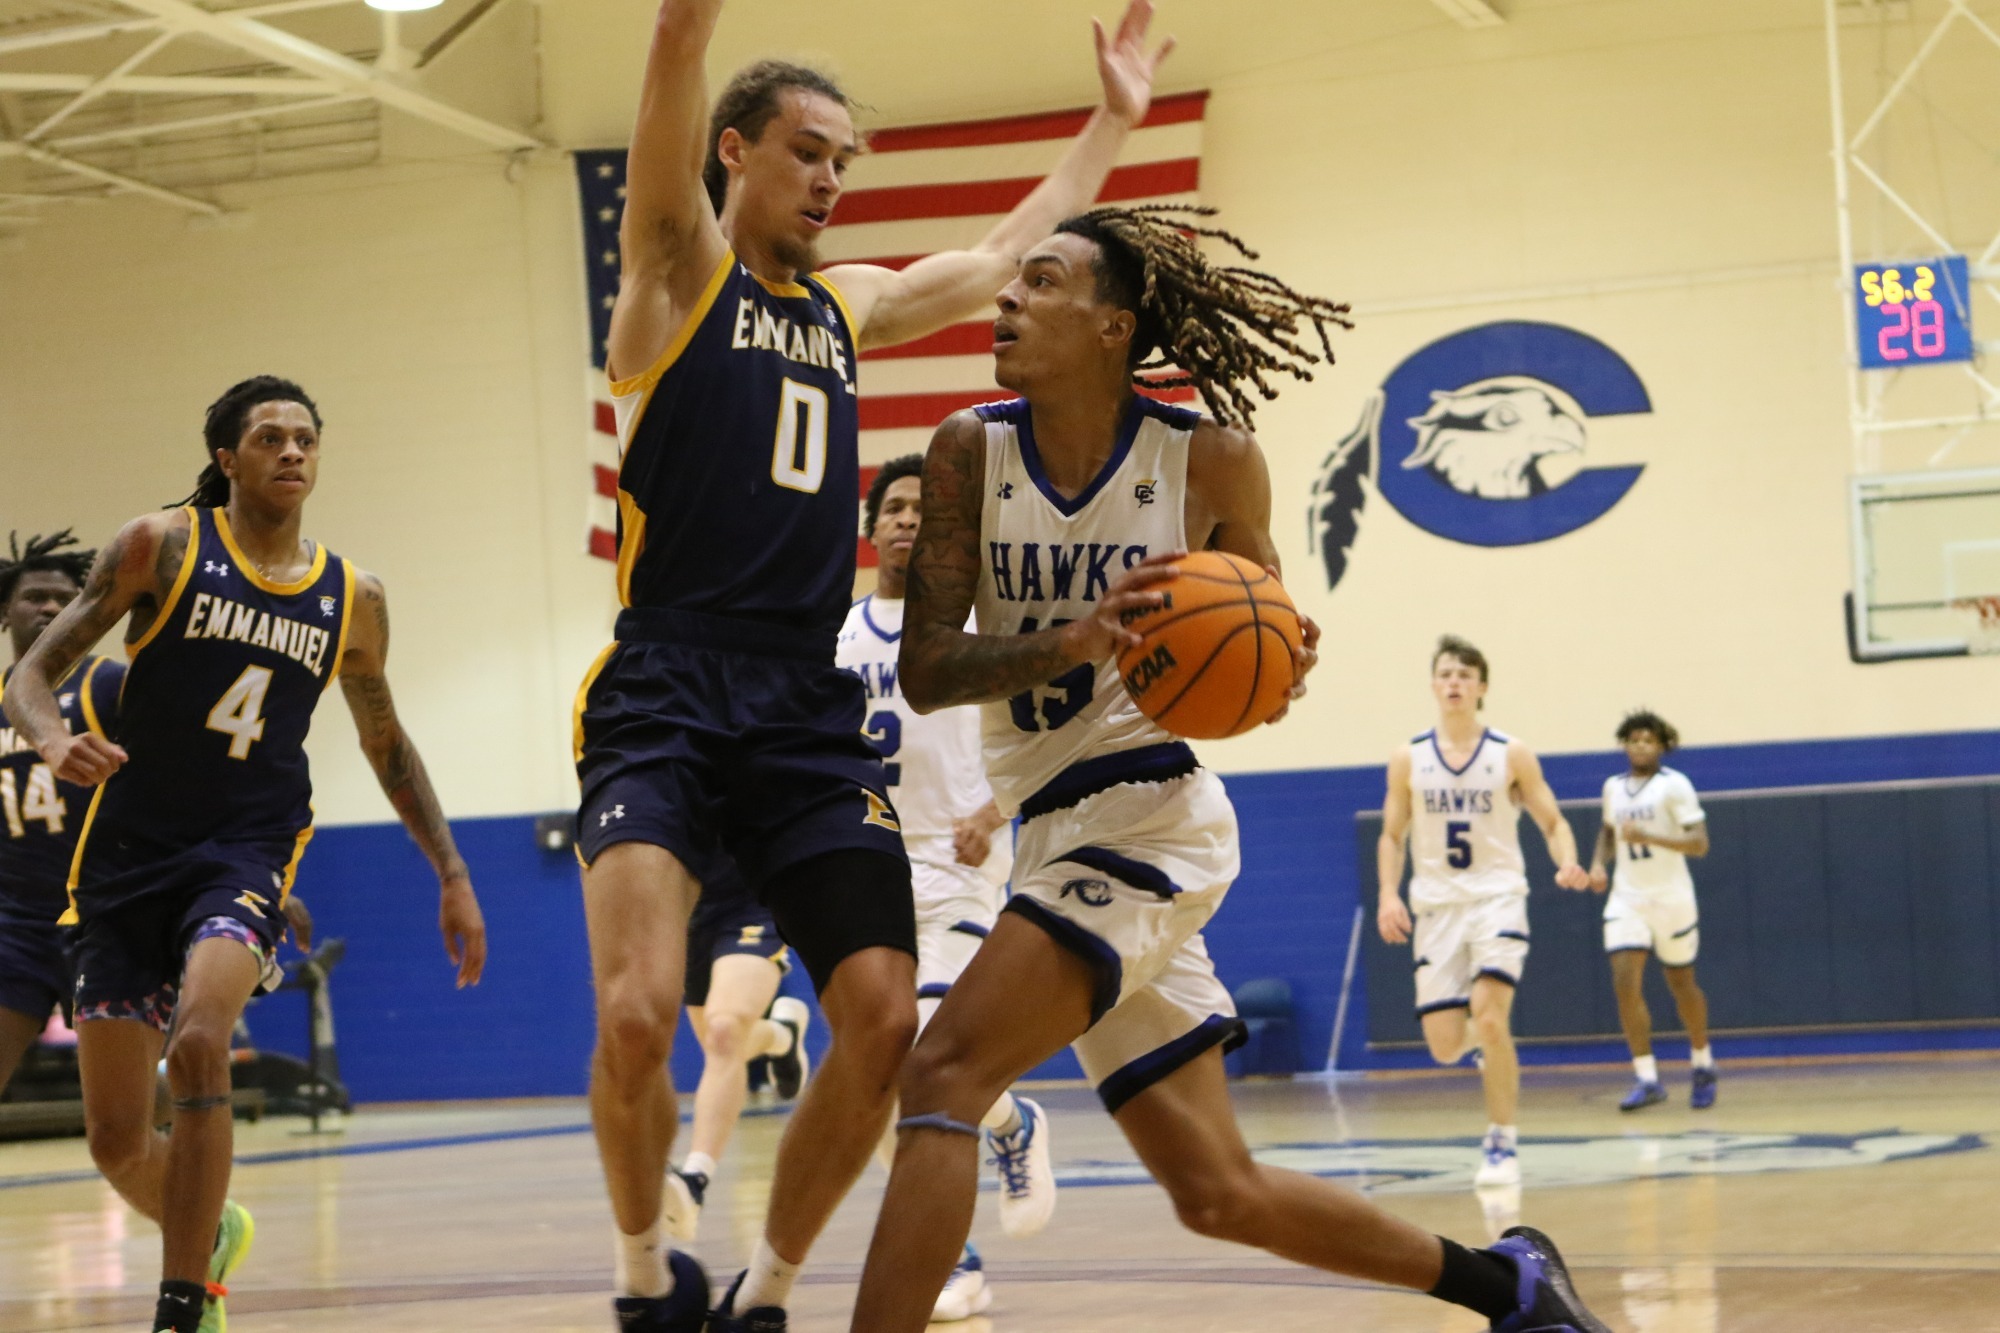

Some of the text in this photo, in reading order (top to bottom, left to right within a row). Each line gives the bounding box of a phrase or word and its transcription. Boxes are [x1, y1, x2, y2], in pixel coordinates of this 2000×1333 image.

[1860, 266, 1935, 307] 56.2
[1878, 300, 1945, 361] 28
[771, 376, 829, 494] 0
[184, 592, 330, 678] EMMANUEL
[205, 664, 274, 760] 4
[0, 763, 68, 838] 14
[1423, 788, 1493, 815] HAWKS
[1446, 820, 1473, 870] 5
